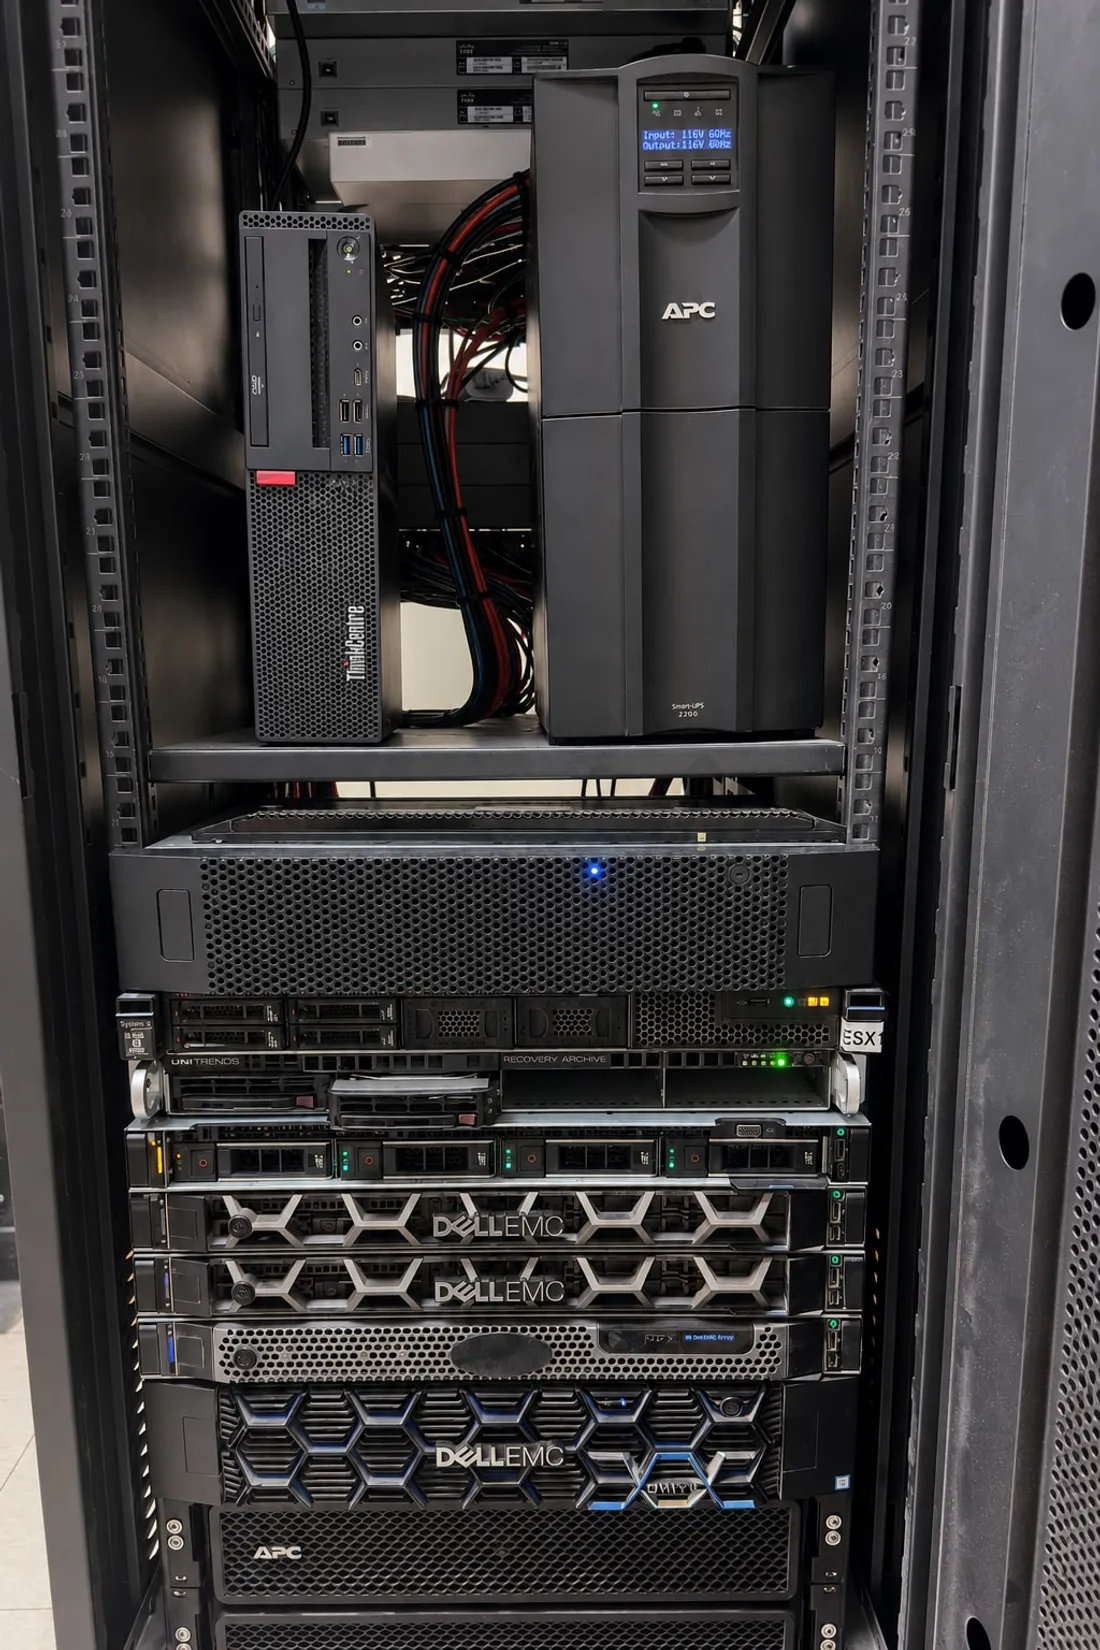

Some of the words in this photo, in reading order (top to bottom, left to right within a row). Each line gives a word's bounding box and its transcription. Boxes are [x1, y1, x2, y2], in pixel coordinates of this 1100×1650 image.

[644, 131, 675, 140] Input:
[682, 130, 704, 139] 116V
[709, 129, 731, 138] 60Hz
[709, 139, 731, 149] 60Hz
[662, 302, 716, 319] APC
[881, 601, 892, 610] 20
[344, 605, 366, 681] ThinkCentre
[678, 710, 699, 718] 2200
[843, 1029, 883, 1046] ESX
[171, 1057, 240, 1066] UNITRENDS
[503, 1055, 559, 1064] RECOVERY
[561, 1055, 607, 1063] ARCHIVE
[253, 1546, 302, 1560] APC
